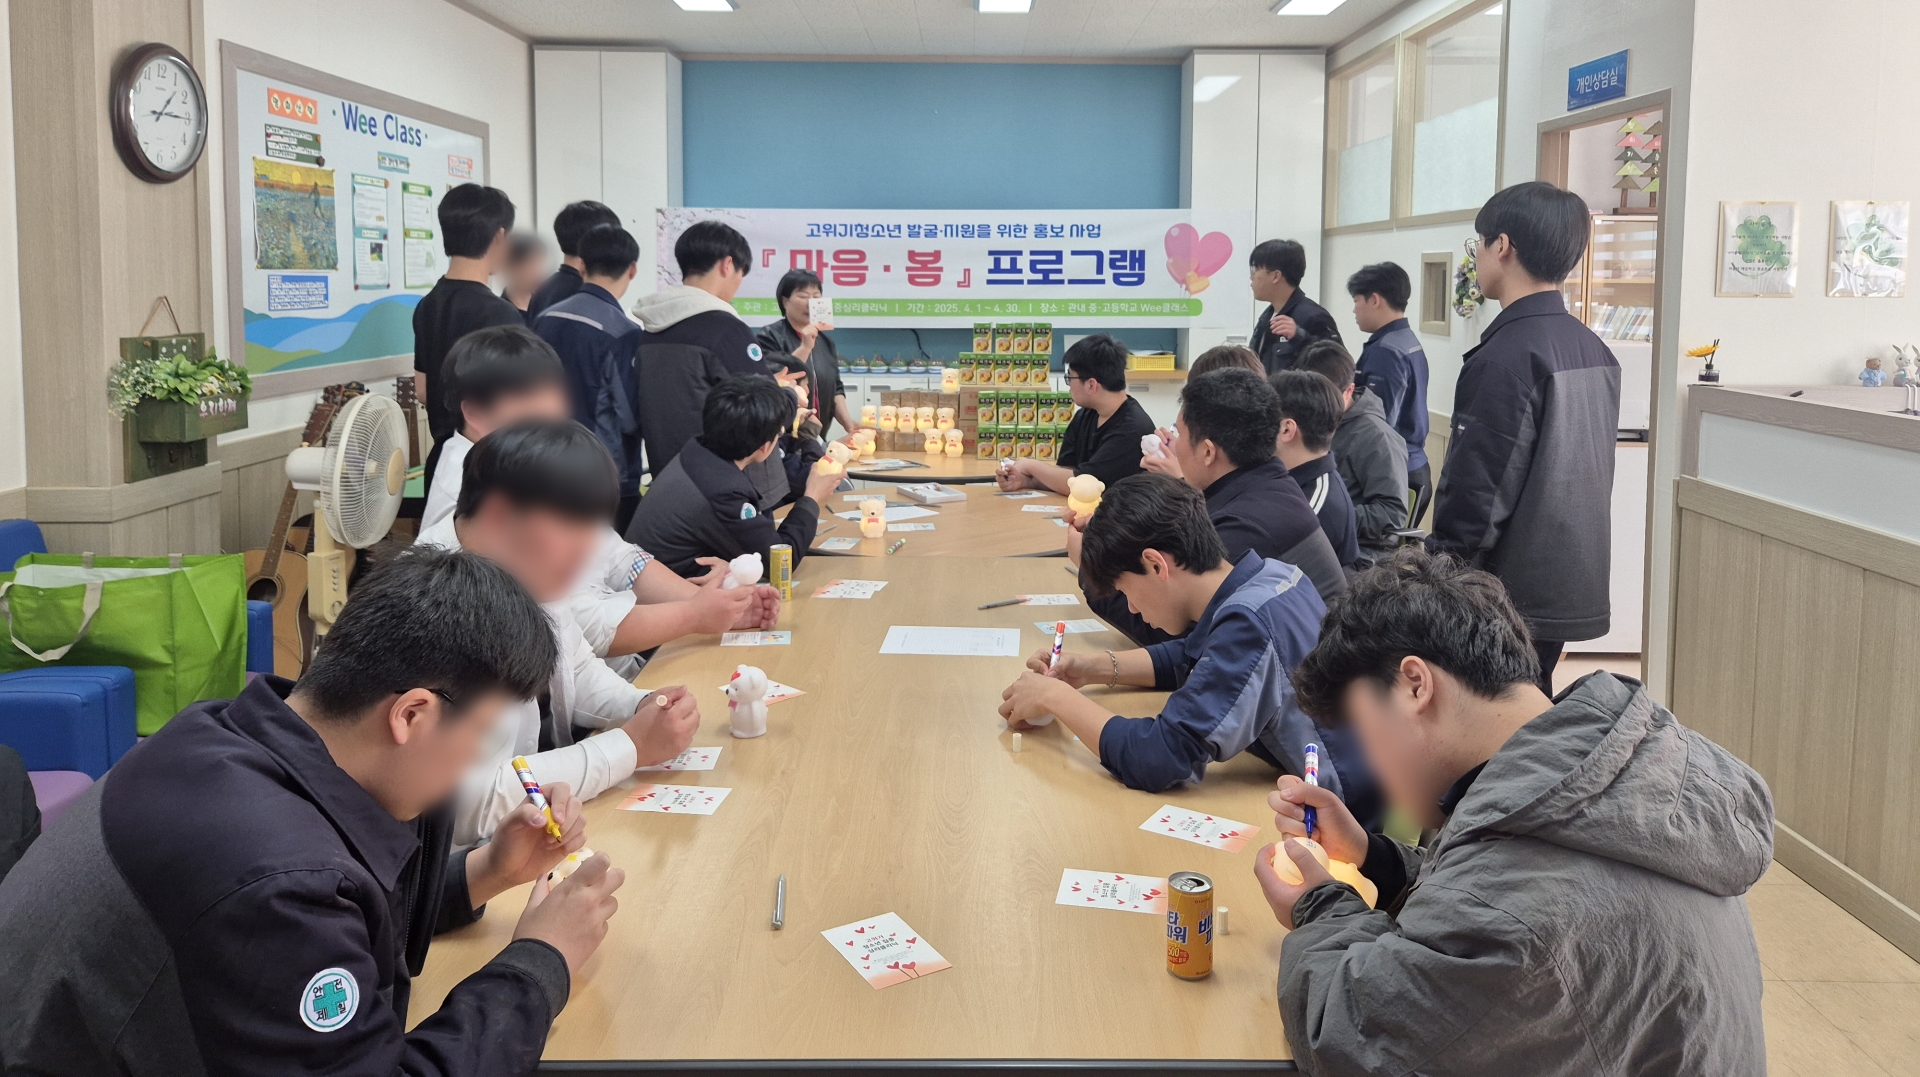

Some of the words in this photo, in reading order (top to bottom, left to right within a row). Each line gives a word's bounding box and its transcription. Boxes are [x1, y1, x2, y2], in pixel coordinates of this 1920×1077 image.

[157, 63, 167, 79] 12
[173, 72, 178, 86] 1
[1576, 66, 1619, 95] 개인상담실
[181, 89, 188, 104] 2
[341, 101, 378, 136] Wee
[383, 114, 422, 147] Class
[181, 132, 187, 146] 4
[156, 150, 163, 164] 6
[170, 146, 177, 160] 5
[806, 223, 902, 239] 고위기청소년
[907, 223, 992, 239] 발굴·지원을
[996, 223, 1029, 239] 위한
[1033, 223, 1065, 239] 홍보
[1069, 223, 1102, 239] 사업
[986, 249, 1146, 287] 프로그램
[743, 302, 762, 313] 주관
[907, 303, 925, 313] 기간
[934, 303, 961, 313] 2025.
[1006, 303, 1021, 313] 30.
[1040, 302, 1059, 313] 장소
[1068, 302, 1086, 313] 관내
[1089, 302, 1138, 313] 중·고등학교
[1140, 302, 1189, 313] Wee클래스
